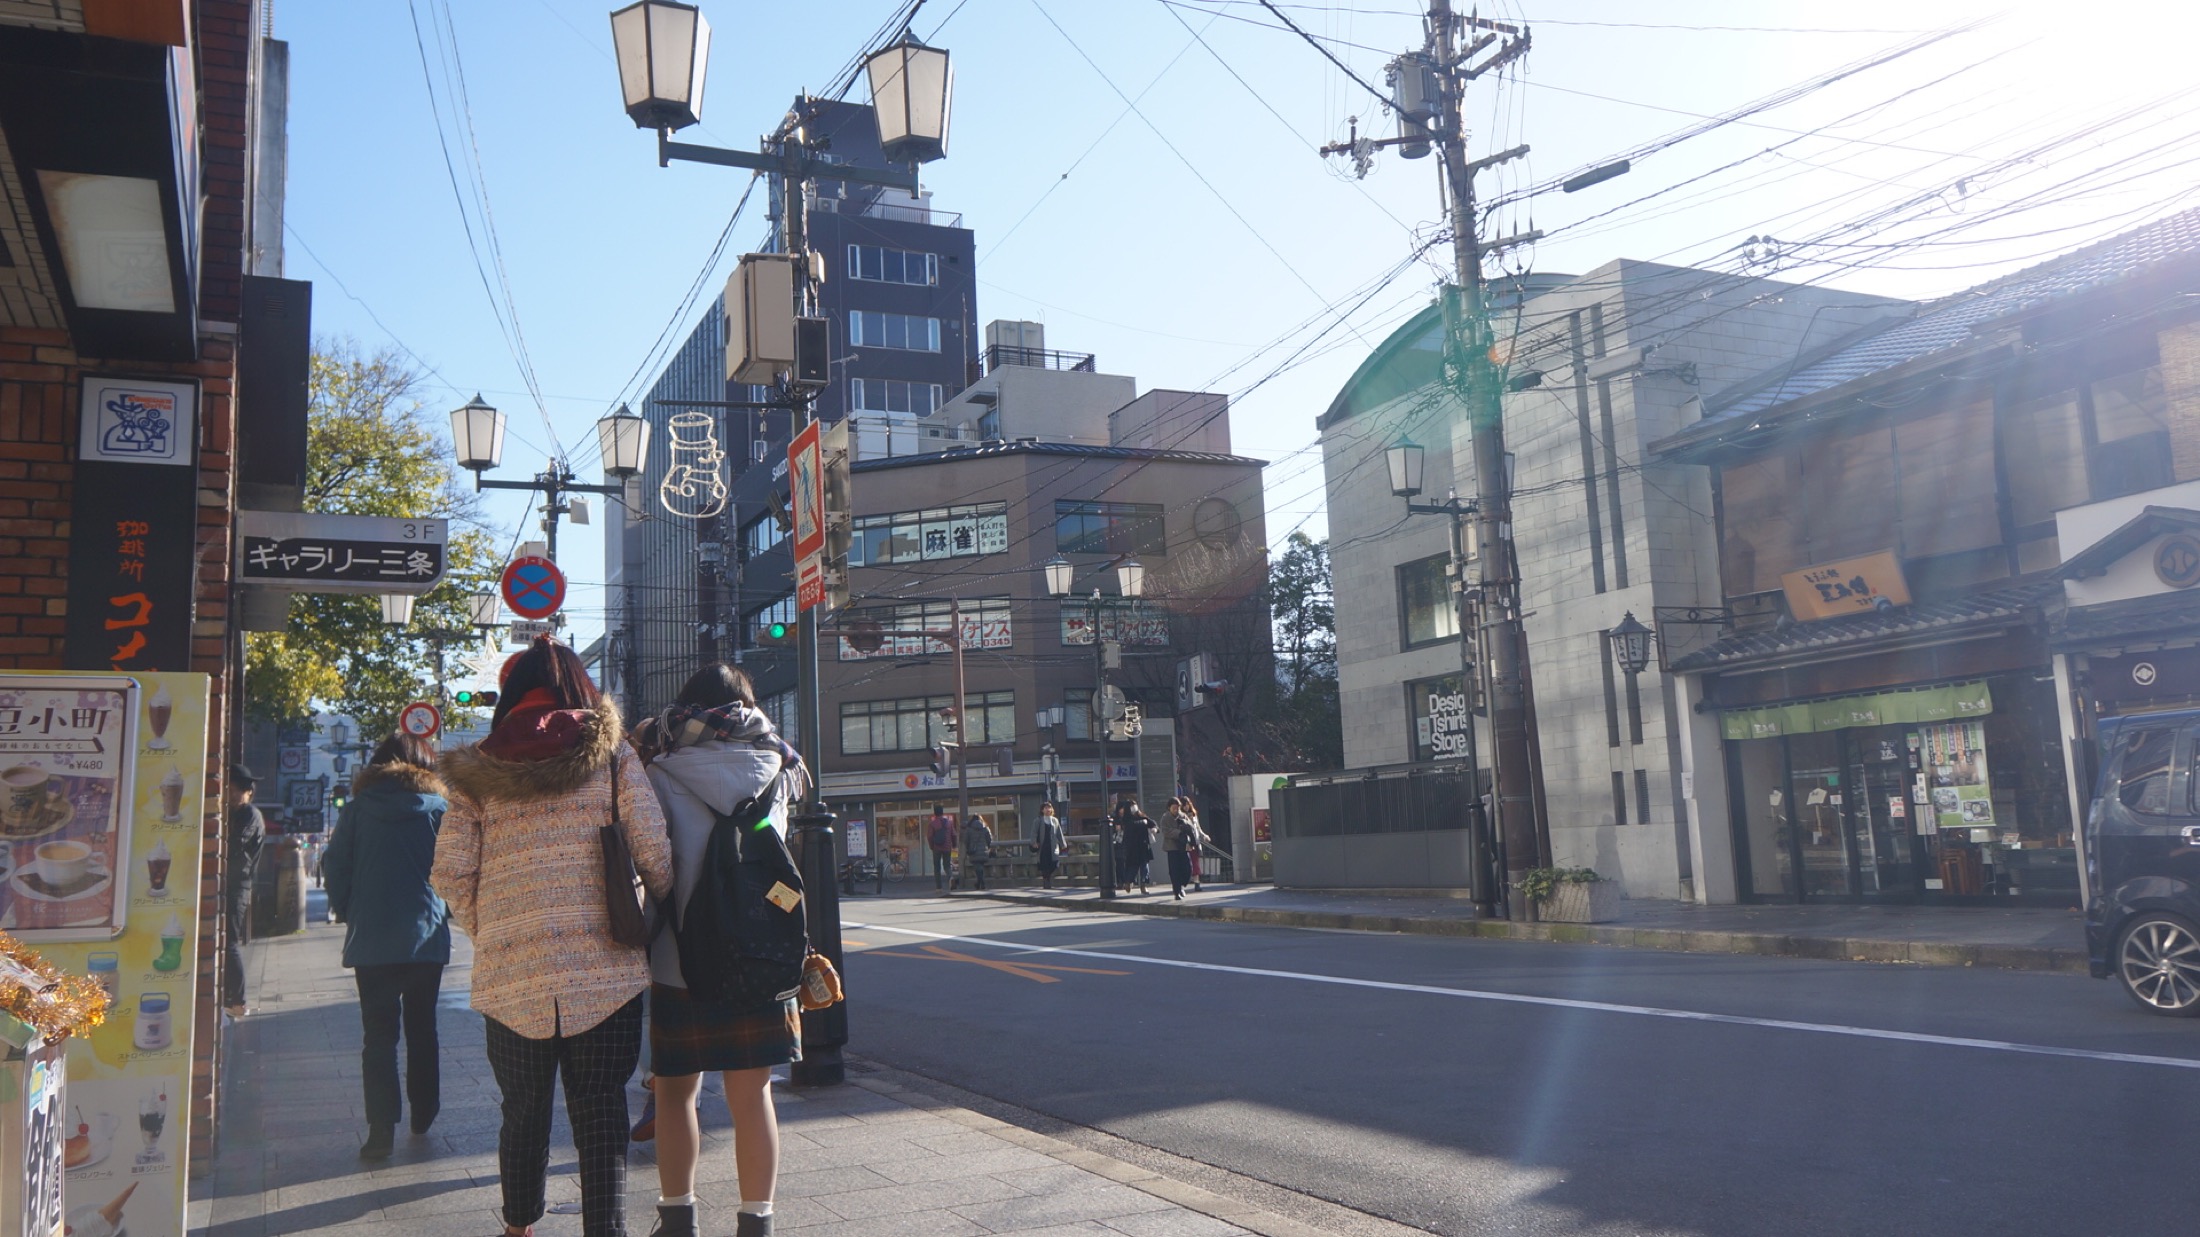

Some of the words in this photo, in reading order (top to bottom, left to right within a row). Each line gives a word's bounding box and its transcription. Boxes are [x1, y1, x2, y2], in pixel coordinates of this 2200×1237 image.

[926, 526, 974, 552] 麻雀
[250, 543, 434, 576] ギャラリー三条
[105, 592, 155, 671] コメ
[1429, 691, 1467, 714] Desig
[1431, 732, 1466, 752] Store
[922, 775, 946, 787] 松屋
[66, 1170, 114, 1180] ニシロノワール
